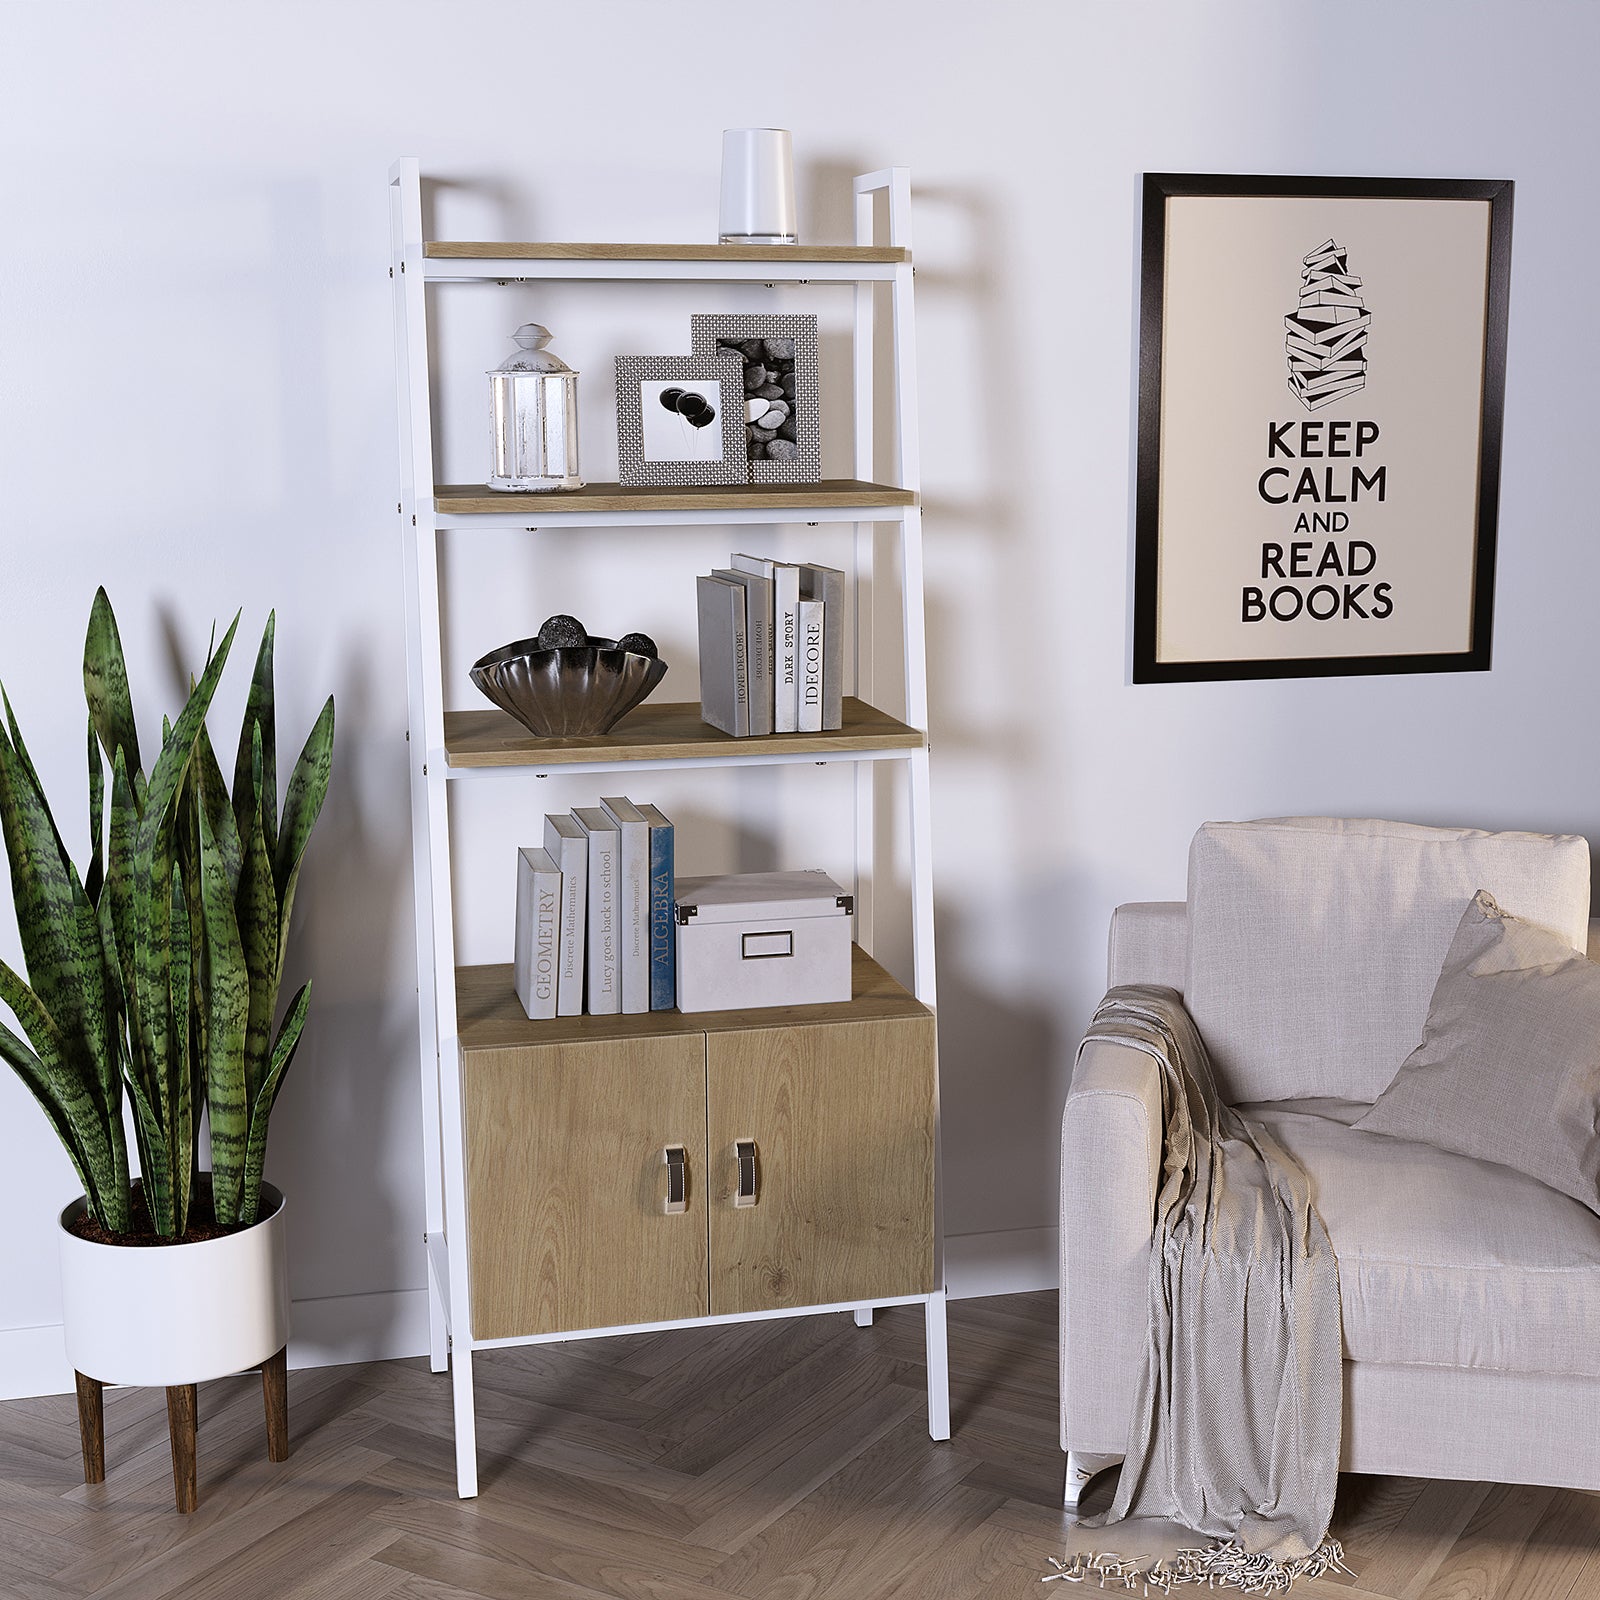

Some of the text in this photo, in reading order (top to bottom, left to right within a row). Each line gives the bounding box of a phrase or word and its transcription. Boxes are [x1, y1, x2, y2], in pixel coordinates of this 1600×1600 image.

[1268, 421, 1380, 458] KEEP
[1258, 466, 1386, 504] CALM
[1293, 512, 1349, 533] AND
[1261, 541, 1377, 578] READ
[1241, 582, 1394, 622] BOOKS
[784, 611, 794, 684] DARK STORY
[805, 623, 820, 706] IDECORE
[536, 889, 555, 1000] GEOMETRY
[564, 876, 577, 979] Discrete Mathematics
[600, 850, 615, 993] Lucy goes back to school
[632, 879, 640, 957] Discrete Mathematics
[654, 871, 669, 966] ALGEBRA
